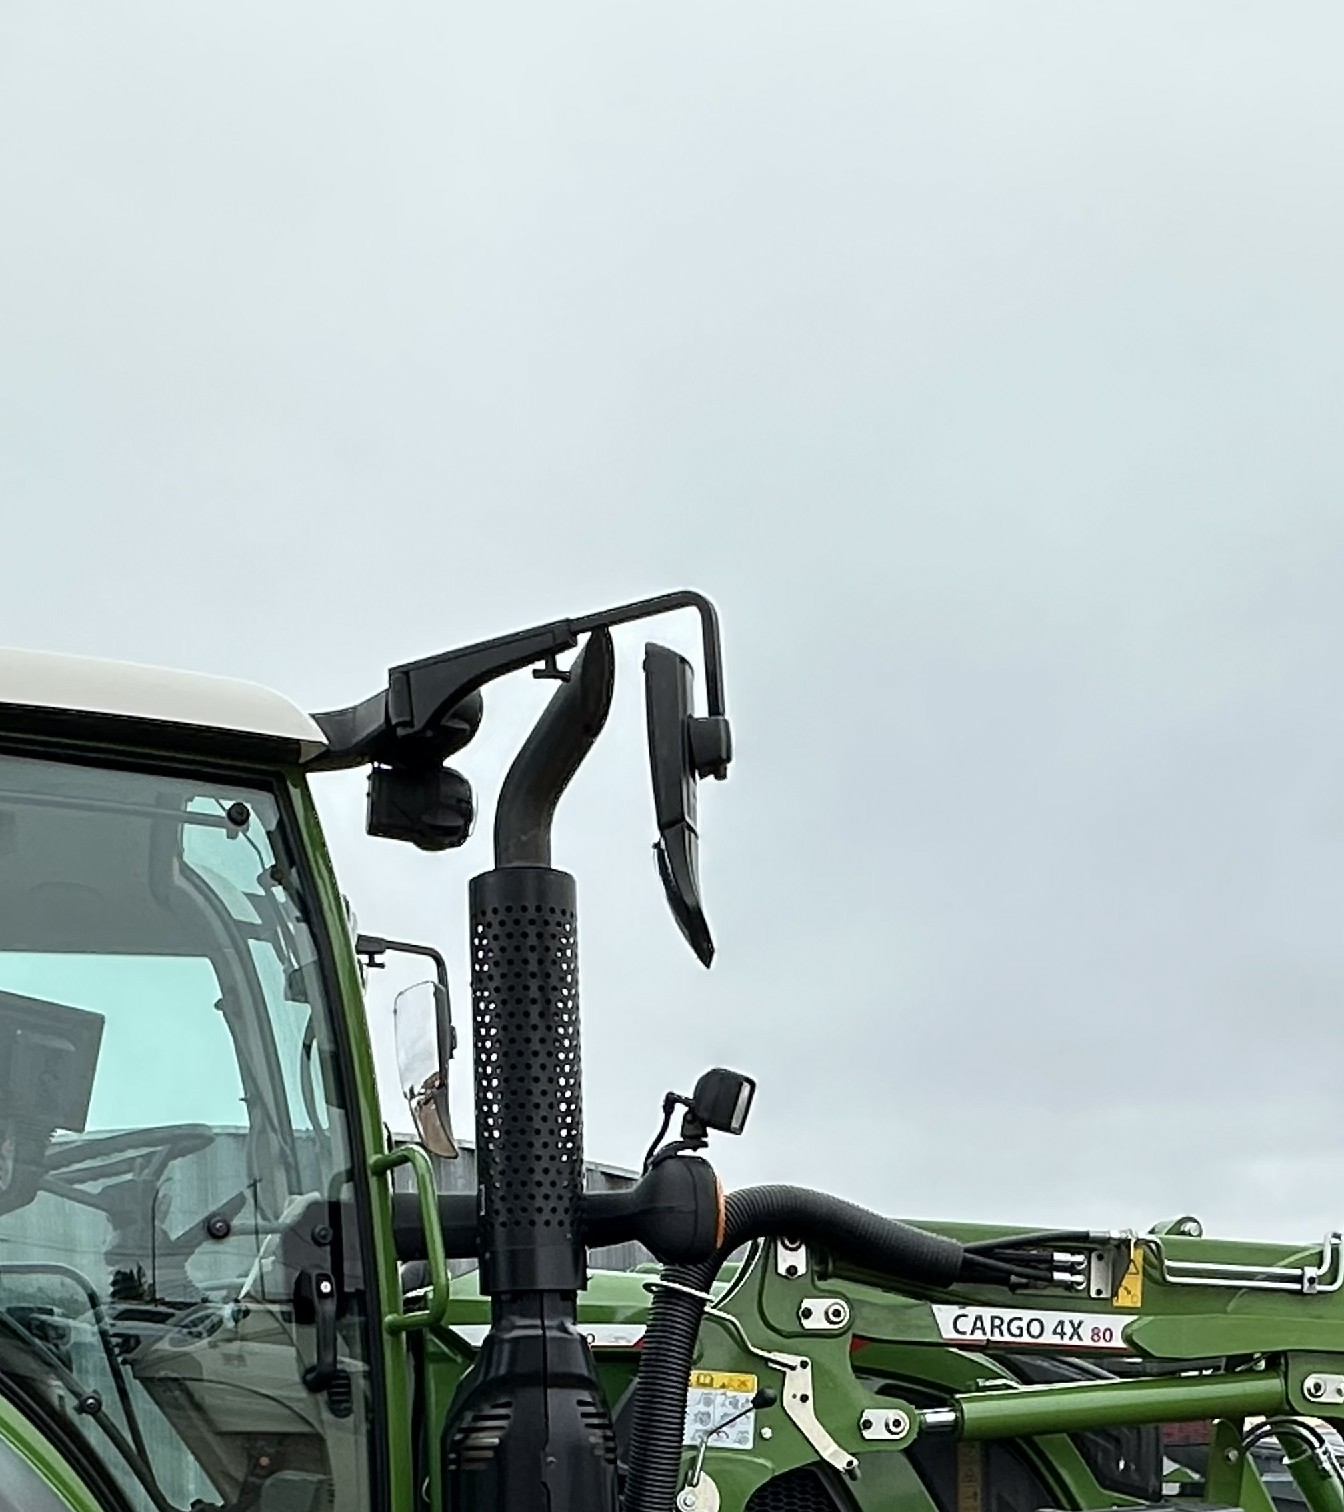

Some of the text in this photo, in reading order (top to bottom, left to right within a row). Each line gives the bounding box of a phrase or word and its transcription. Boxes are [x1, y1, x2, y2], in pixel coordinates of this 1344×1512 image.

[952, 1313, 1114, 1343] CARGO 4X 80
